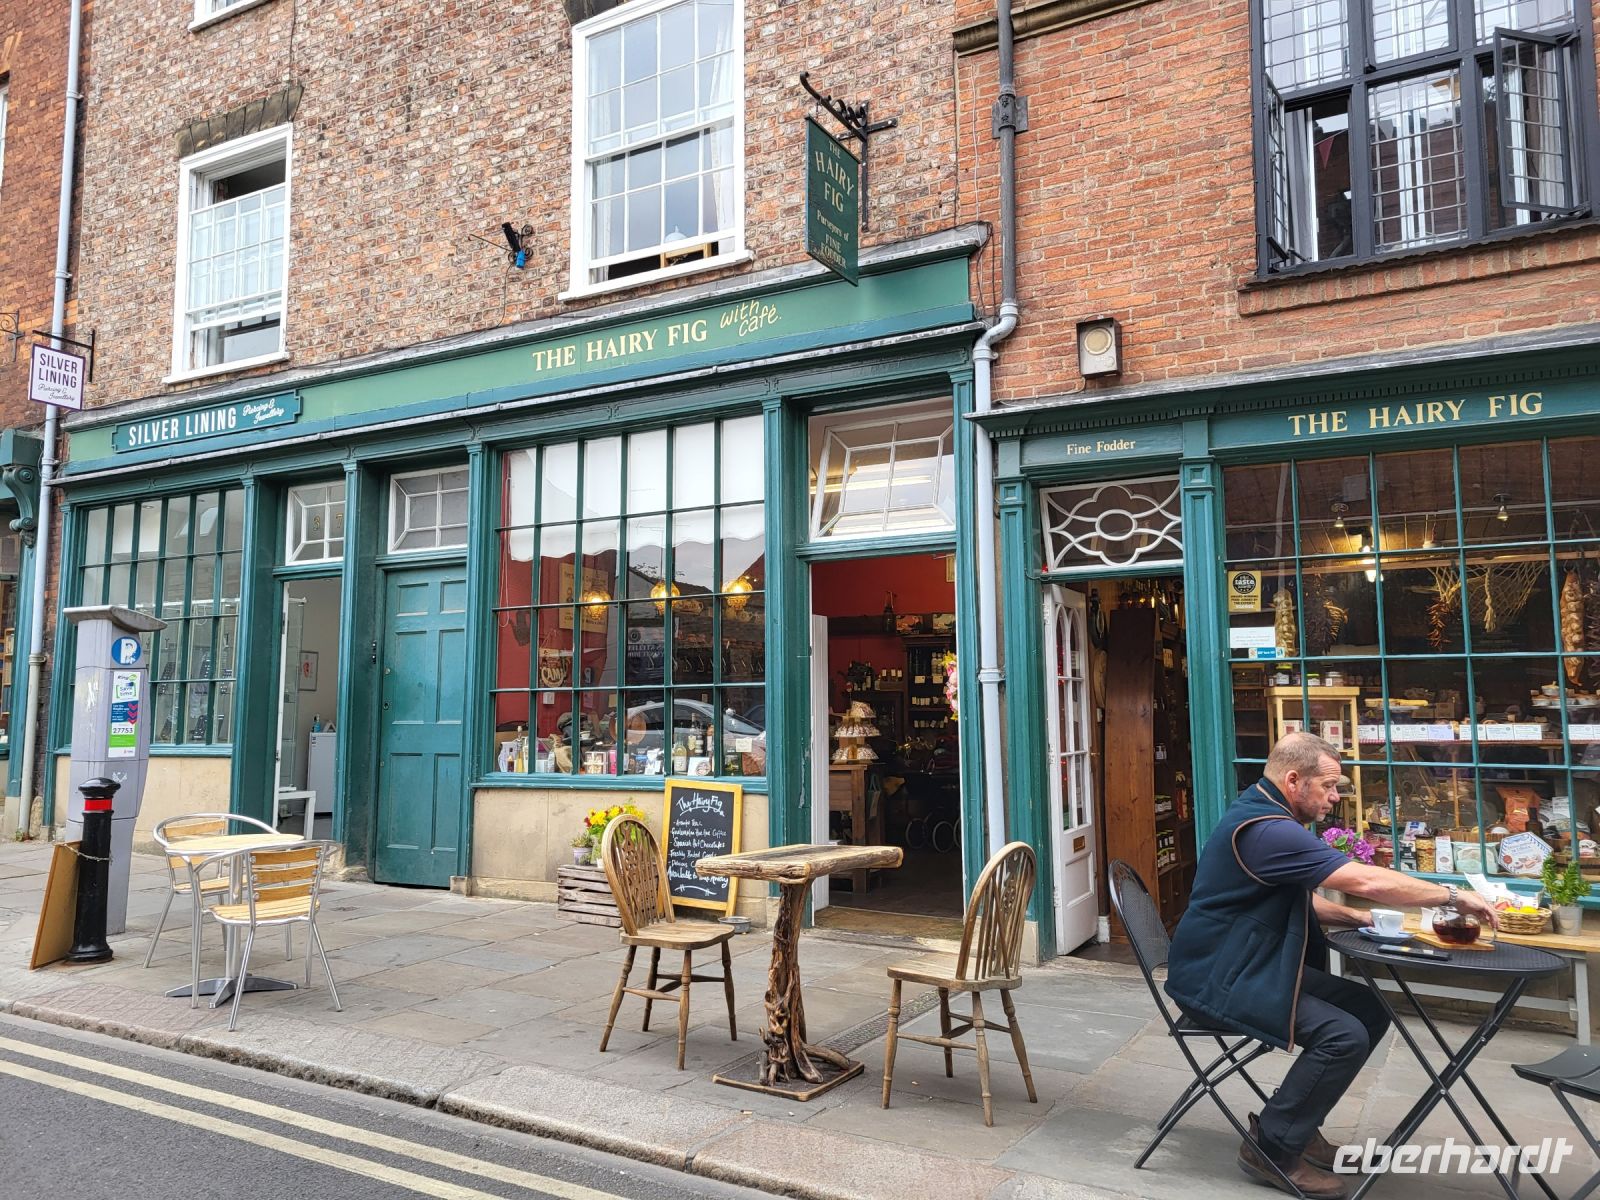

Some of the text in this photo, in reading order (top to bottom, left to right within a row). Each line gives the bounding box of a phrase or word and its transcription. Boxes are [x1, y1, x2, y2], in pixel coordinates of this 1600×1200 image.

[829, 140, 840, 160] THE
[815, 151, 854, 197] HAIRY
[824, 181, 844, 213] FIG
[817, 210, 849, 242] Purveyors of
[826, 234, 842, 253] FINE
[720, 299, 760, 330] with
[532, 319, 708, 372] THE HAIRY FIG
[38, 368, 77, 388] LINING
[40, 353, 78, 374] SILVER
[128, 407, 236, 446] SILVER LINING
[1288, 392, 1543, 436] THE HAIRY FIG
[1067, 439, 1136, 455] Fine Fodder
[676, 796, 691, 811] The
[711, 795, 722, 812] Fig
